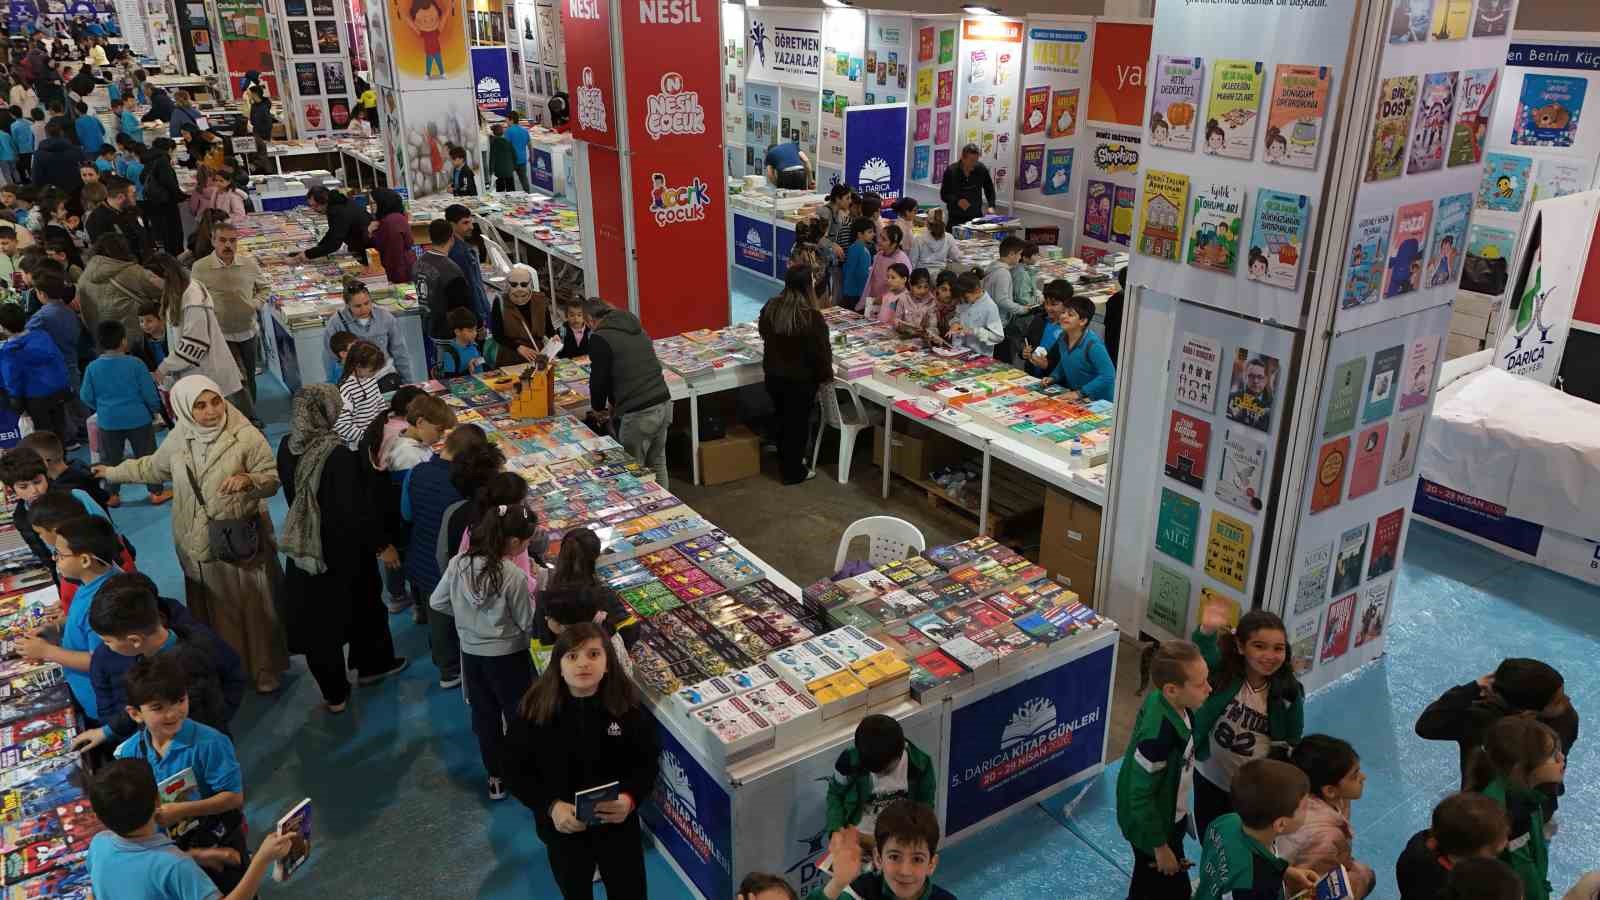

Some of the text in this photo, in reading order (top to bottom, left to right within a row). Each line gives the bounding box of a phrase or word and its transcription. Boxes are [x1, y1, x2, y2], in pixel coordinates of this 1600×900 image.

[774, 32, 819, 51] ÖĞRETMEN
[774, 51, 819, 68] YAZARLAR
[1528, 48, 1572, 64] Benim
[1382, 100, 1411, 118] DOST
[1507, 346, 1545, 371] DARICA
[964, 753, 1009, 780] DARICA
[1011, 736, 1048, 760] KİTAP
[1048, 706, 1101, 744] GÜNLERİ
[1214, 720, 1257, 757] 82
